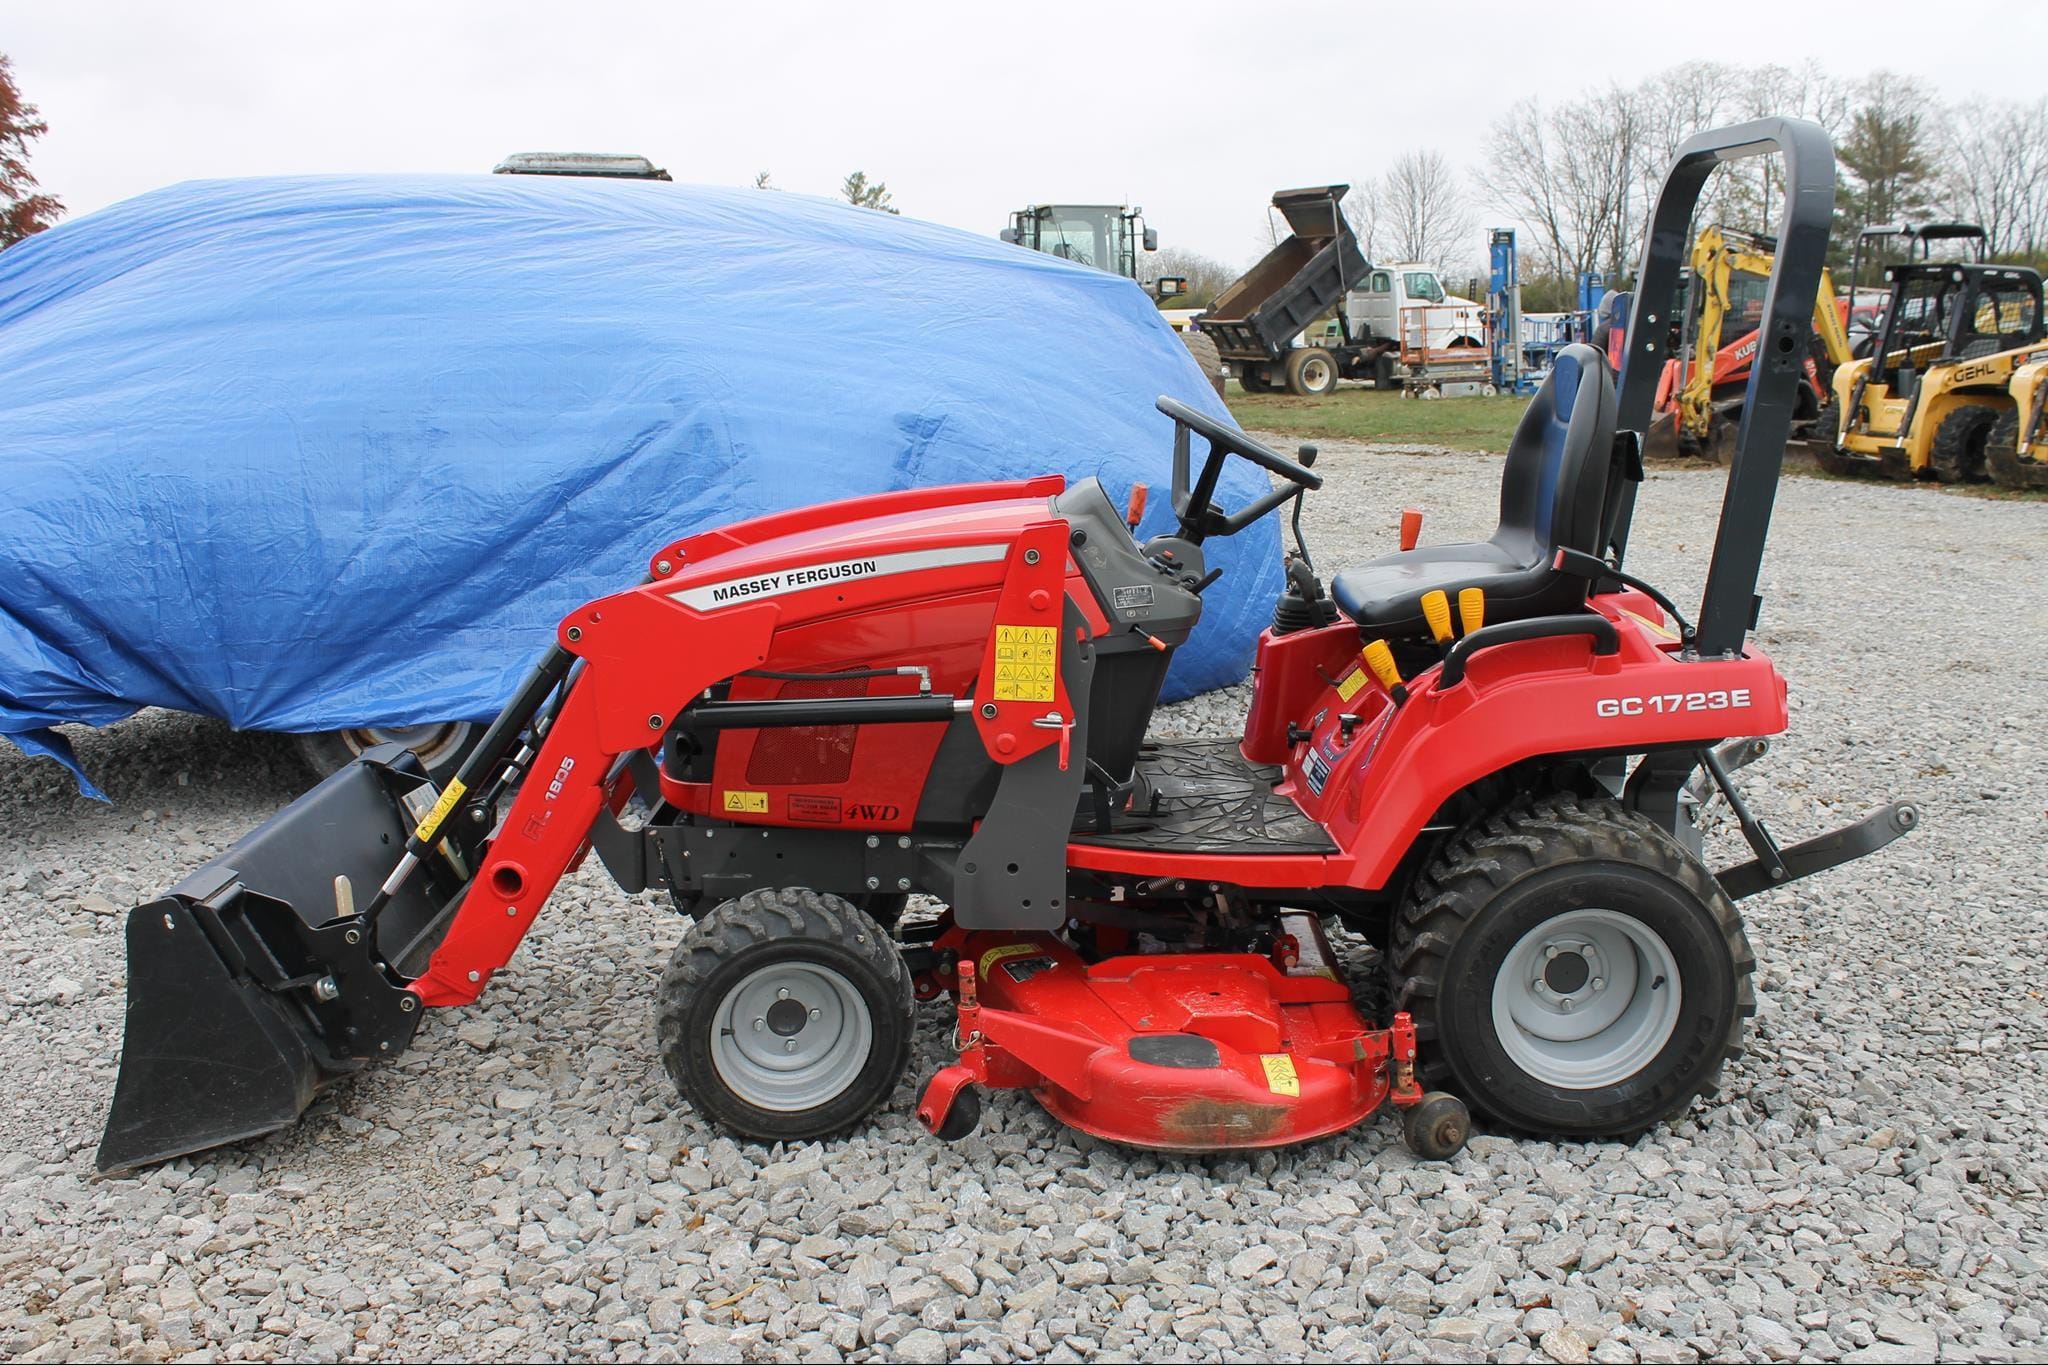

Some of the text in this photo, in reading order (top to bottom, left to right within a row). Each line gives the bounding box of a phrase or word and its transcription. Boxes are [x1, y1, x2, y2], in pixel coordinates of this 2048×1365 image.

[1734, 340, 1759, 361] KUB
[1953, 364, 1996, 383] GEHL
[713, 560, 877, 602] MASSEY FERGUSON
[1596, 688, 1752, 718] GC 1723E
[544, 755, 576, 801] 1805
[844, 803, 900, 821] 4WD
